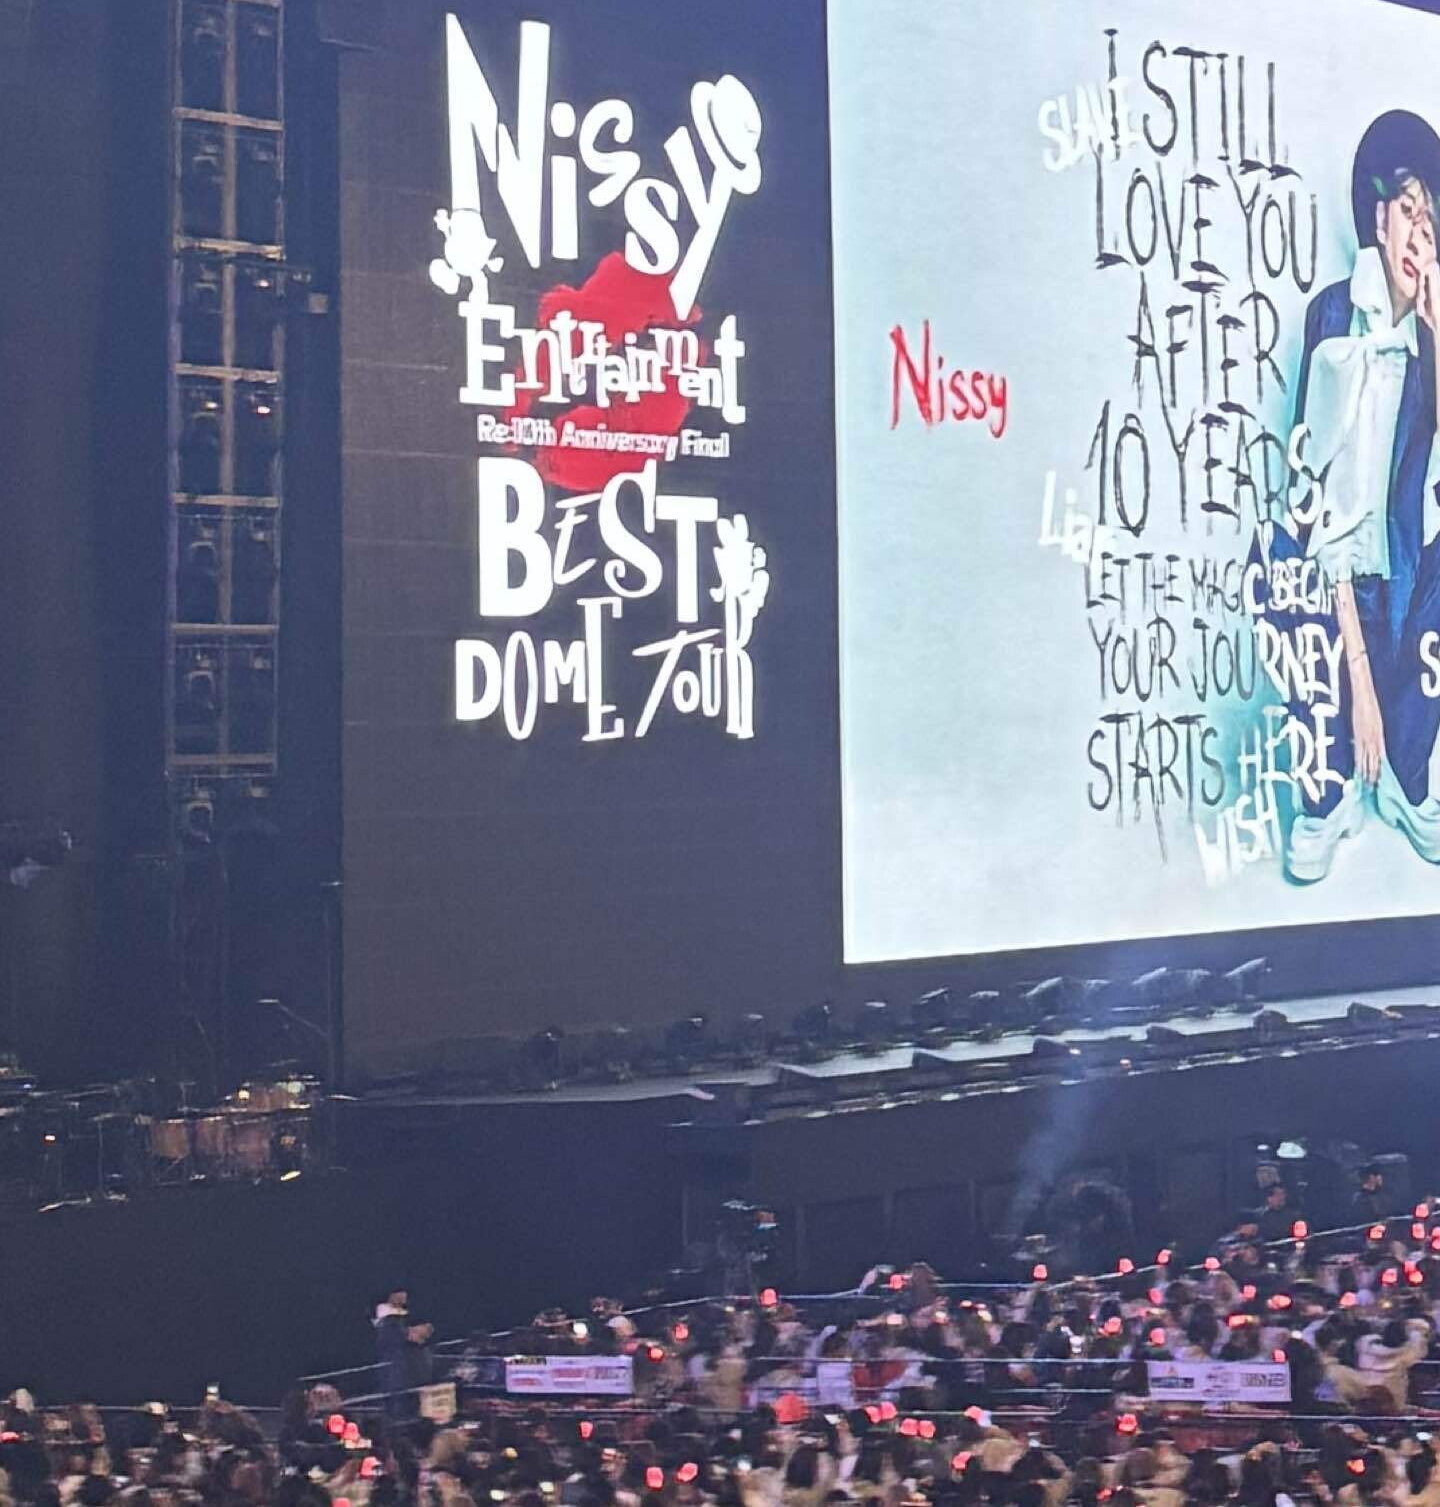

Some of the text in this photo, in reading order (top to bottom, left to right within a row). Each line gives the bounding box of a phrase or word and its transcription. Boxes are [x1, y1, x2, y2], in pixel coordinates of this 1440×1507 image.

[446, 13, 761, 321] Nissy
[1143, 40, 1302, 180] STILL
[1093, 142, 1318, 294] LOVE YOU
[889, 319, 1007, 439] Nissy
[1126, 270, 1288, 420] AFTER
[561, 421, 678, 462] Anniversary
[680, 429, 731, 458] Final
[1084, 399, 1151, 538] 10
[478, 458, 718, 623] BEST
[1085, 551, 1130, 612] LET
[1134, 551, 1184, 611] THE
[455, 594, 756, 741] DOME TOUR
[1088, 614, 1344, 708] YOUR JOURNEY
[1087, 702, 1352, 860] STARTS HERE
[1194, 780, 1284, 887] WISH
